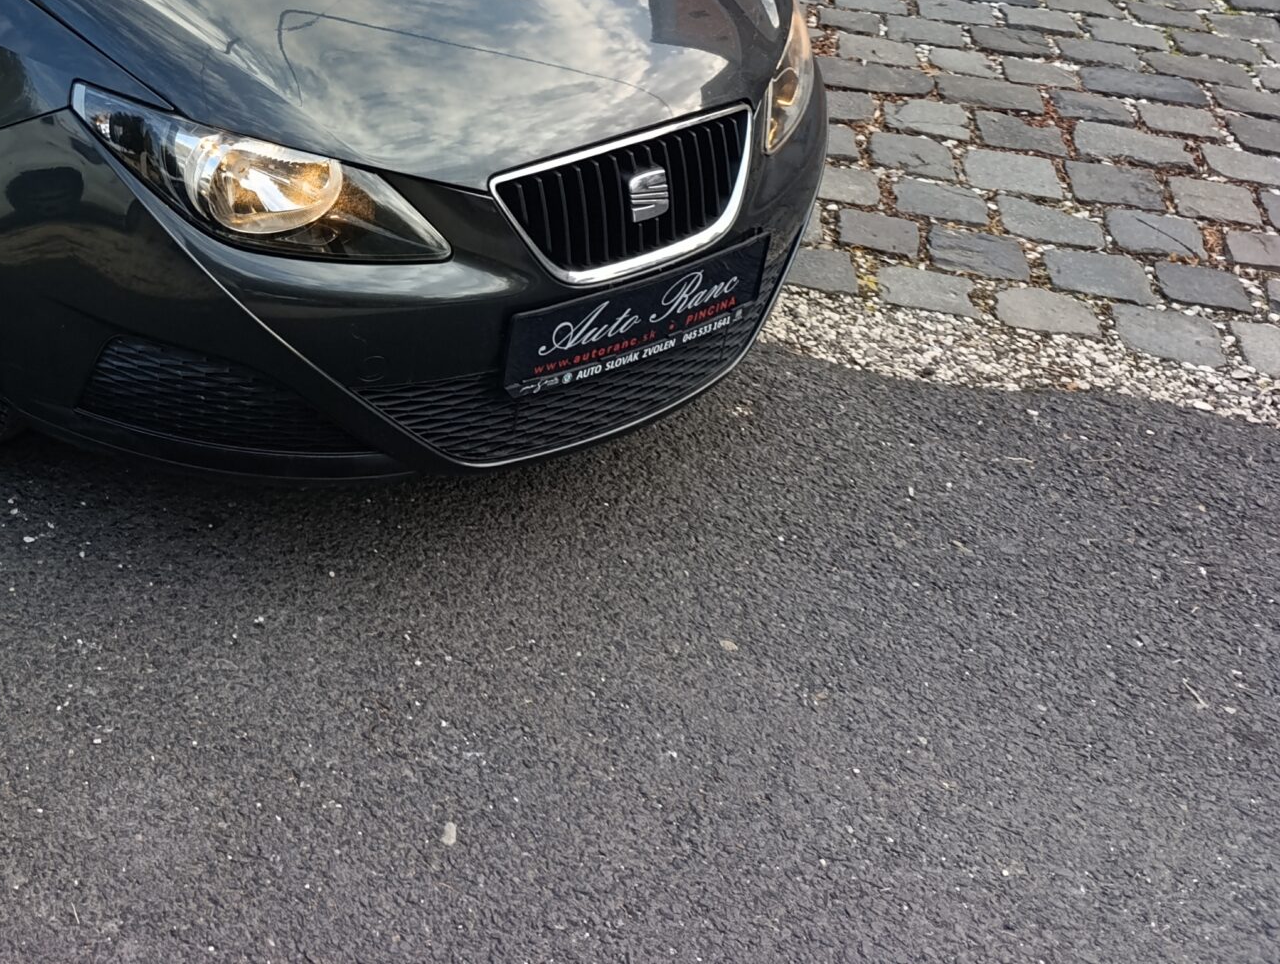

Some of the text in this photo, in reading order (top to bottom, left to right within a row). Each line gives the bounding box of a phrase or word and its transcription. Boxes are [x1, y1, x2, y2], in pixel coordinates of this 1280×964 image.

[538, 300, 641, 356] Auto
[575, 364, 603, 381] AUTO
[641, 338, 677, 358] ZVOLEN
